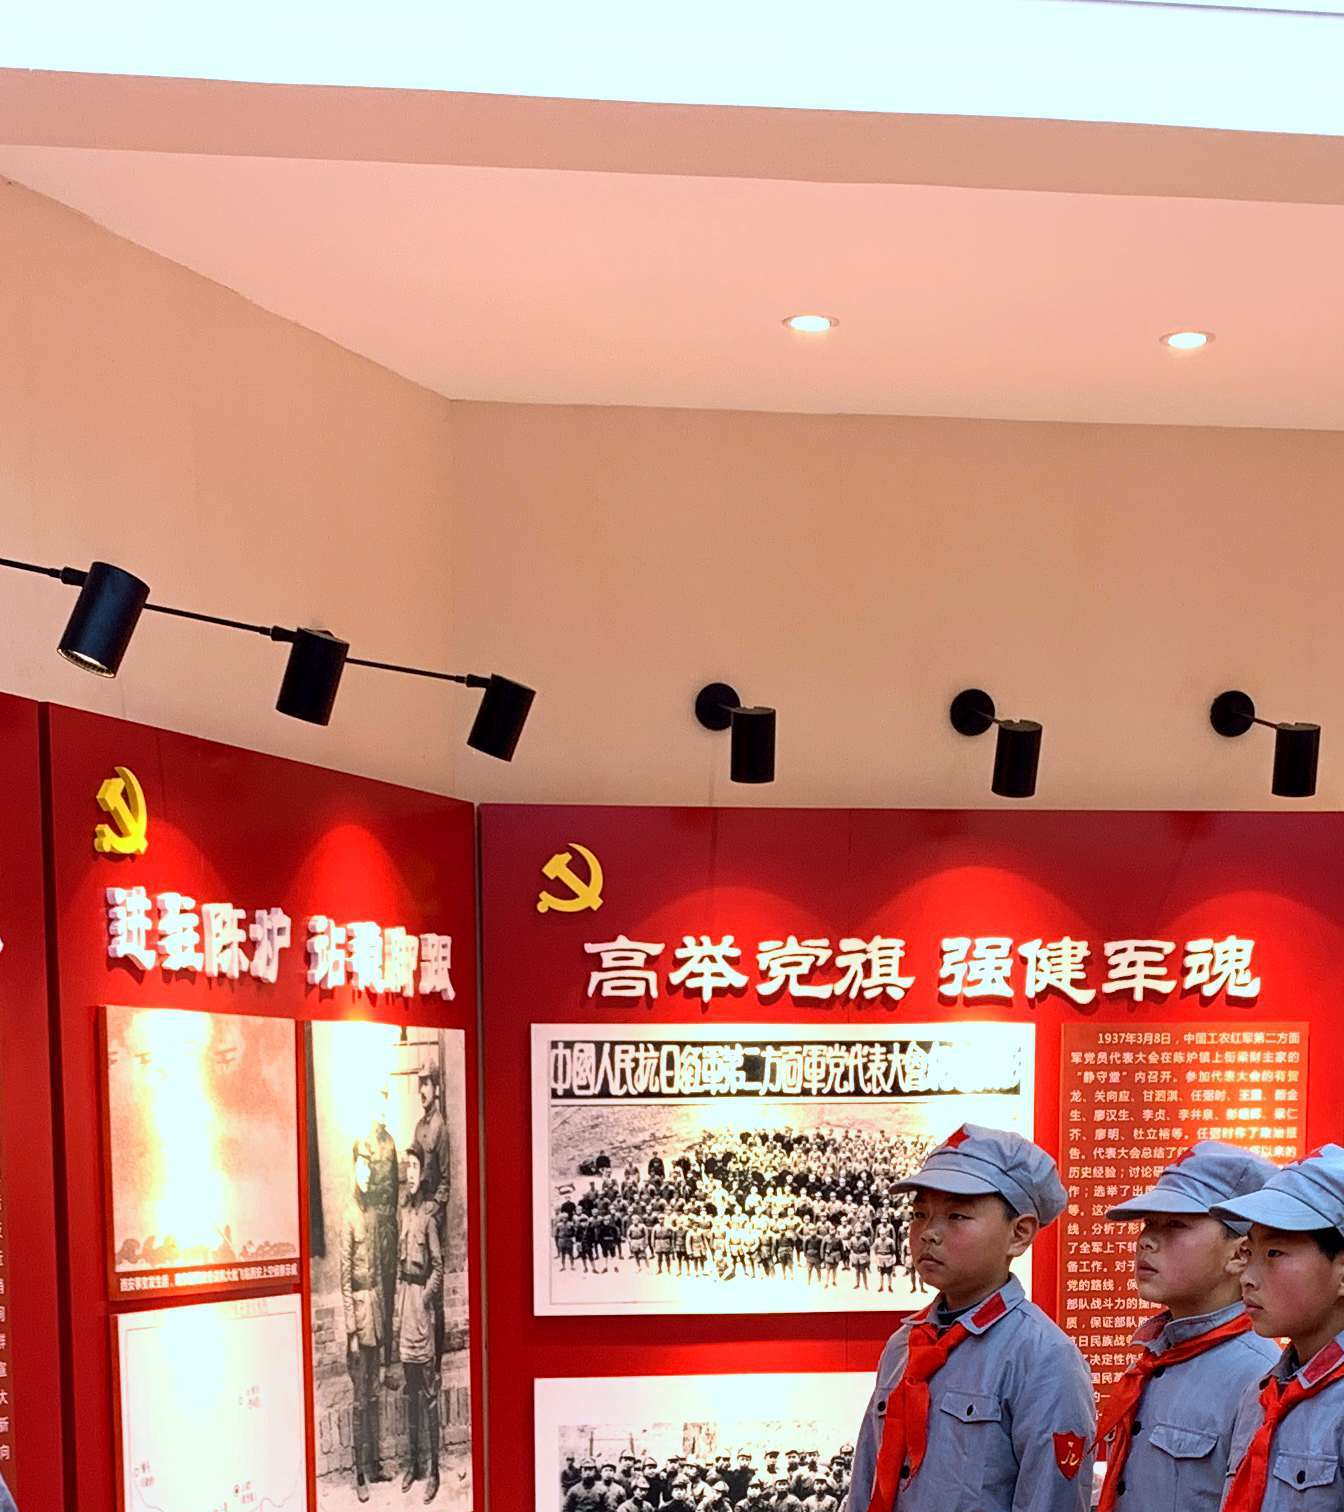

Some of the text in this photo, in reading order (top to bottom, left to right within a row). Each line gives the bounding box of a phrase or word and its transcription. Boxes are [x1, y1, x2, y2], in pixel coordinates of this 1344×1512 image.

[584, 933, 1262, 1004] 高举党旗 强健军魂
